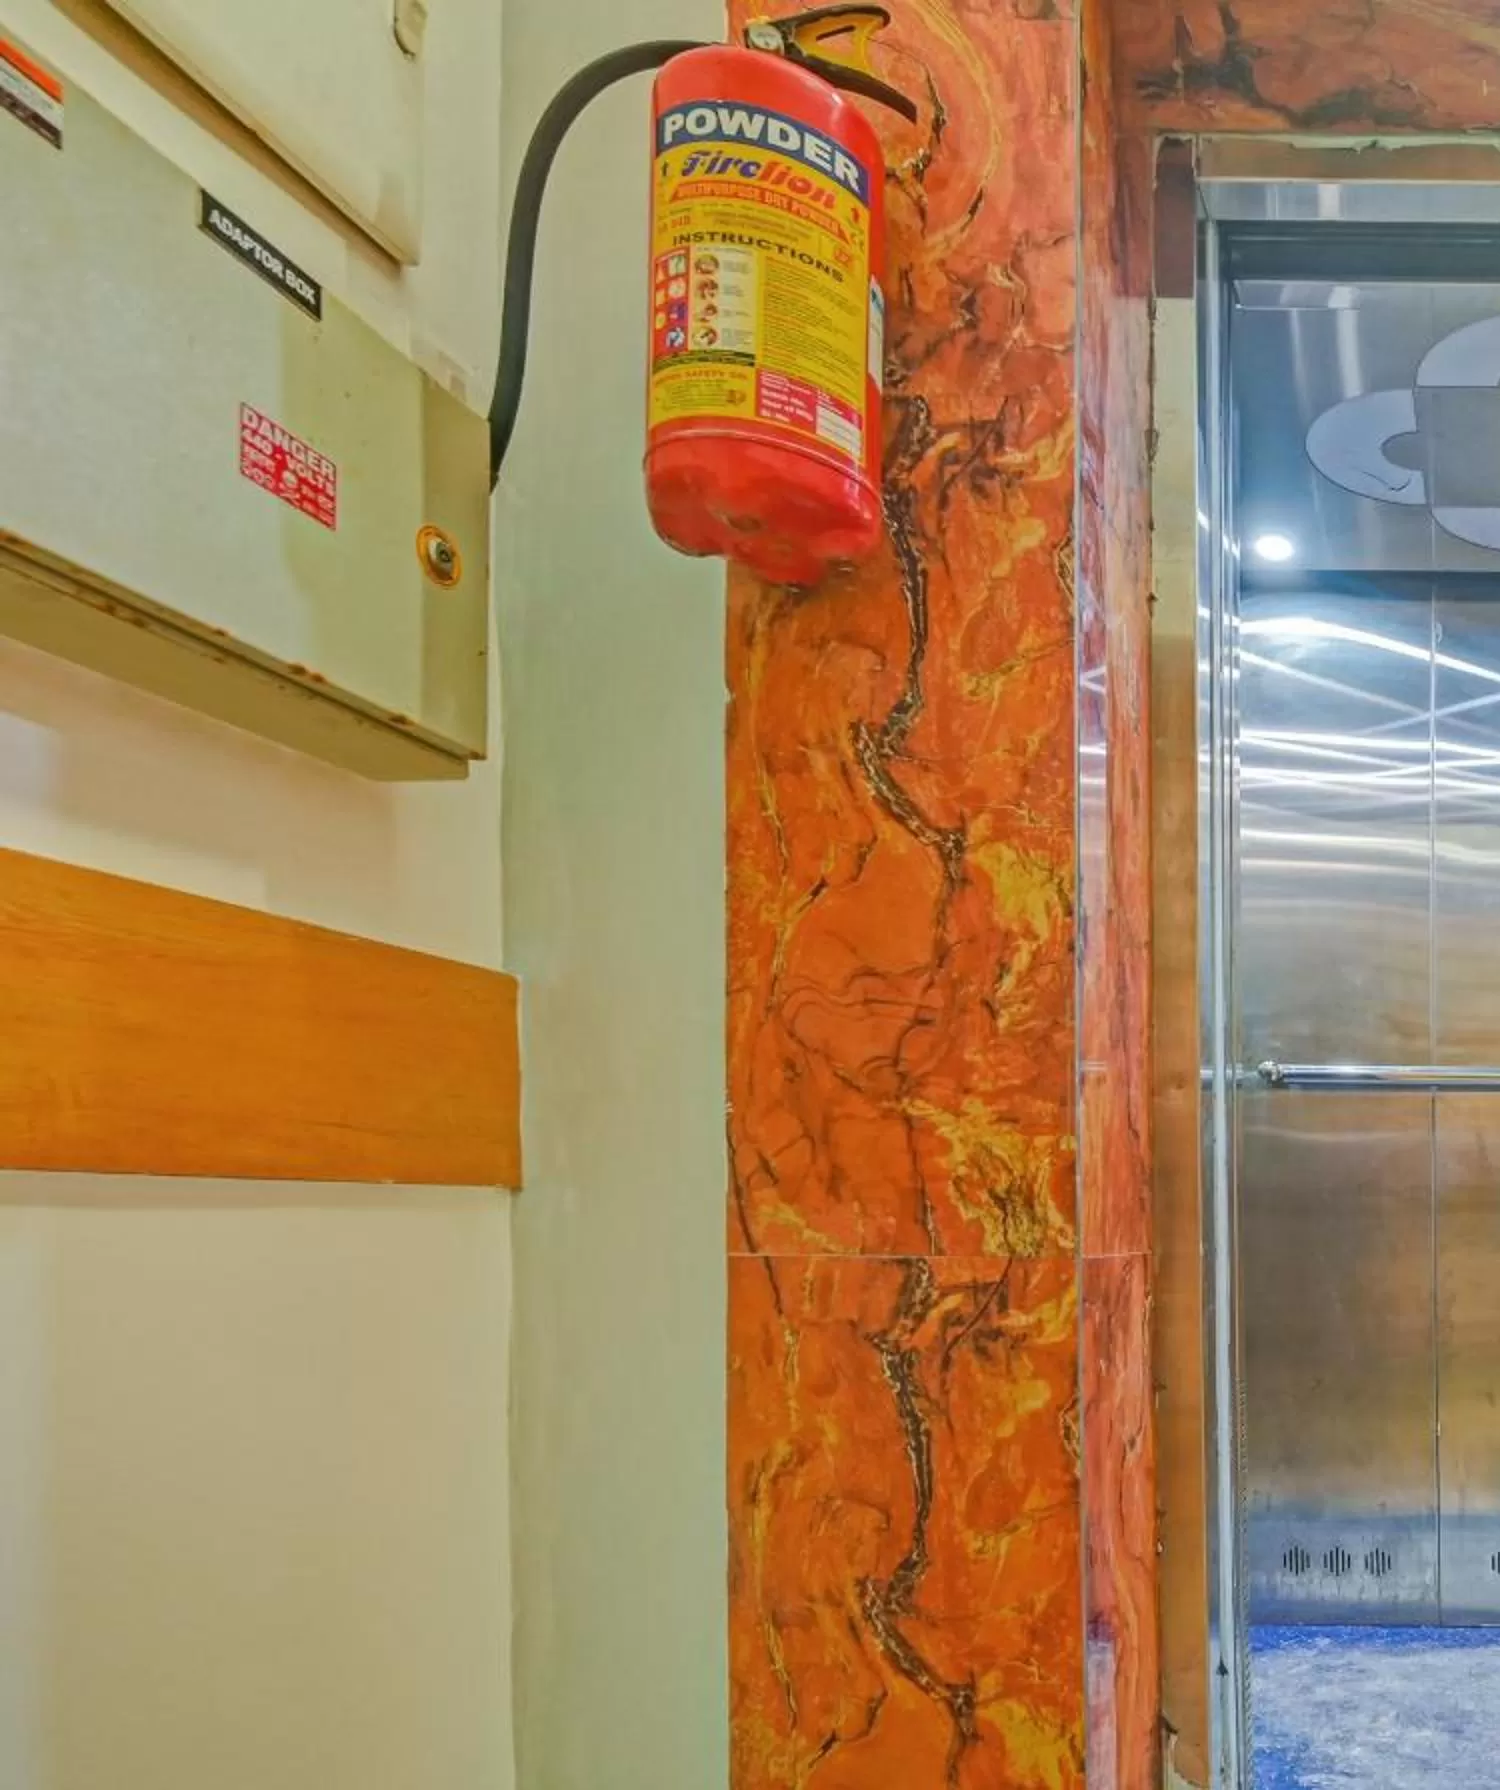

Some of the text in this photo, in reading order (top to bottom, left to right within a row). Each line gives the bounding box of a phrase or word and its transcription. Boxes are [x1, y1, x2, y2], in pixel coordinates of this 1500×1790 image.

[663, 107, 861, 195] POWDER
[208, 209, 316, 305] ADAPTOR BOX
[673, 231, 845, 284] INSTRUCTIONS
[241, 405, 335, 482] DANGER
[285, 454, 335, 498] VOLTS
